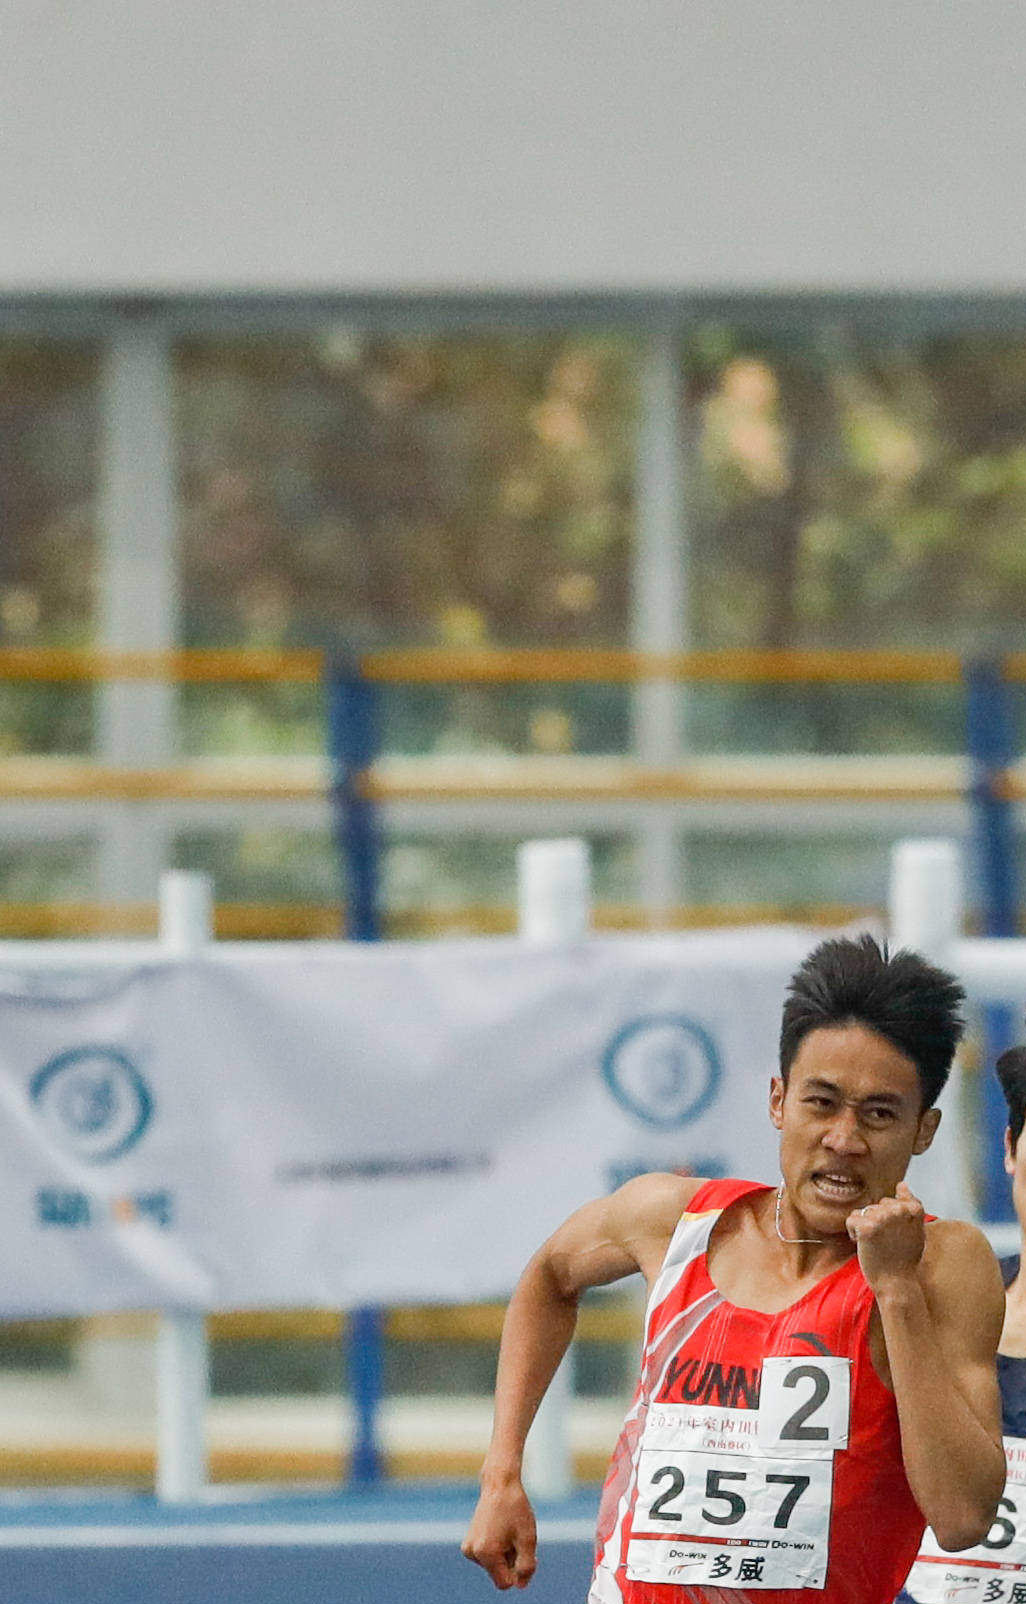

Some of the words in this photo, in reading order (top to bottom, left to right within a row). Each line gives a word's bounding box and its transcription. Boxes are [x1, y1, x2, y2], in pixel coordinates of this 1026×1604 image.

[661, 1356, 759, 1409] YUNN
[780, 1365, 830, 1440] 2
[648, 1466, 811, 1529] 257
[708, 1553, 766, 1582] 多威
